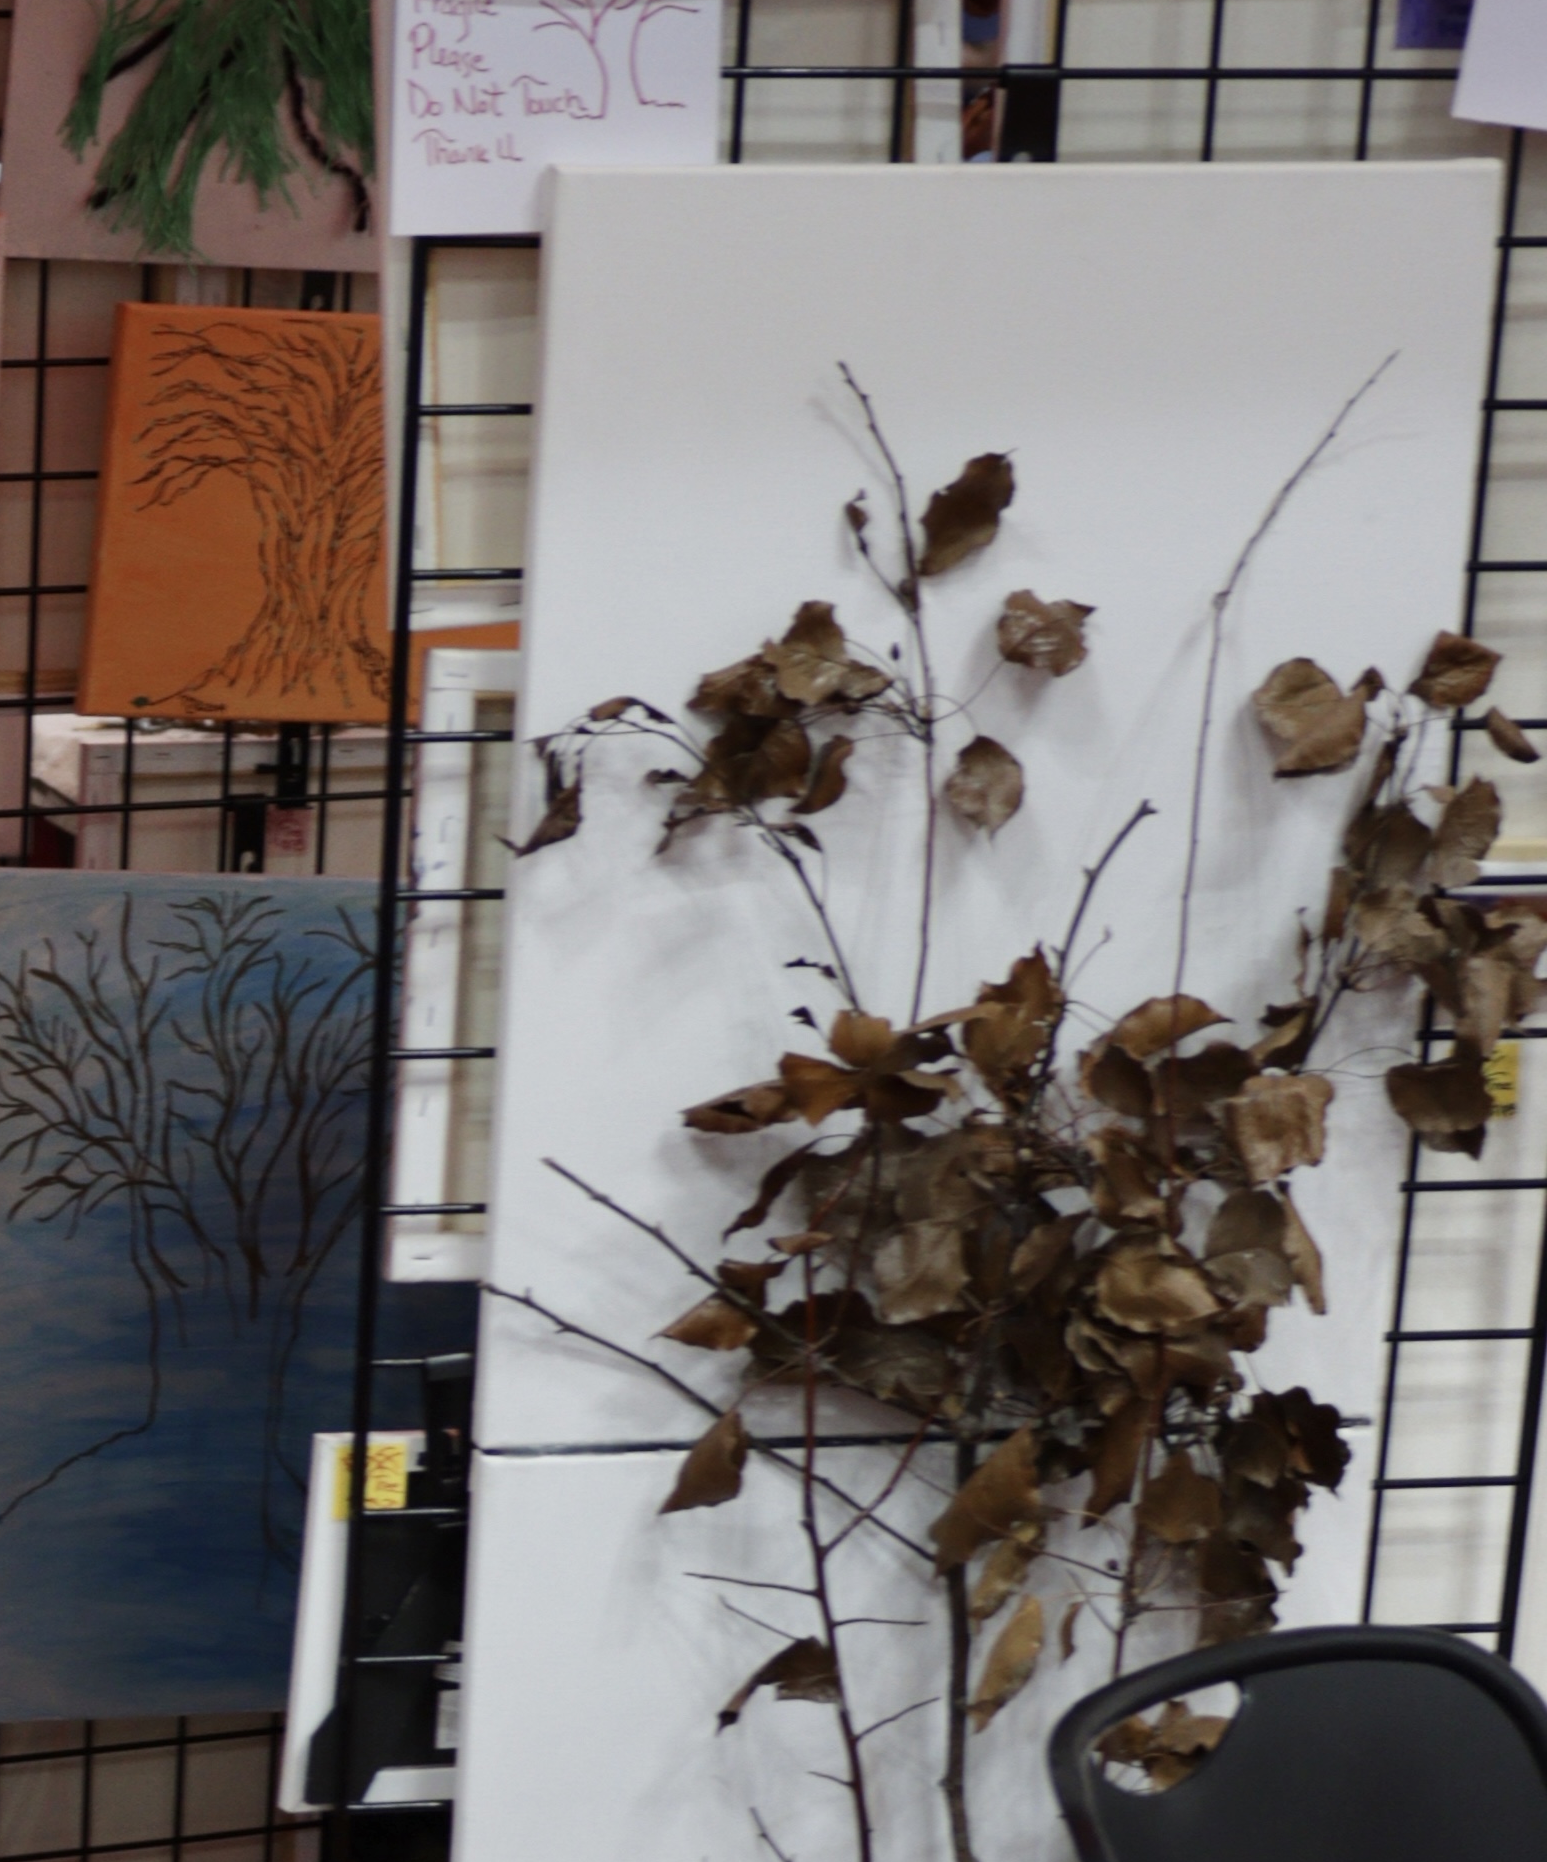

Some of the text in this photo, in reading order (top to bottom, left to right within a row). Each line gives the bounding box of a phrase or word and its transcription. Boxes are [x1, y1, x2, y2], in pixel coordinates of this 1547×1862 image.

[408, 22, 492, 78] Please
[407, 74, 591, 119] Do Not Touch
[412, 128, 492, 167] Thank
